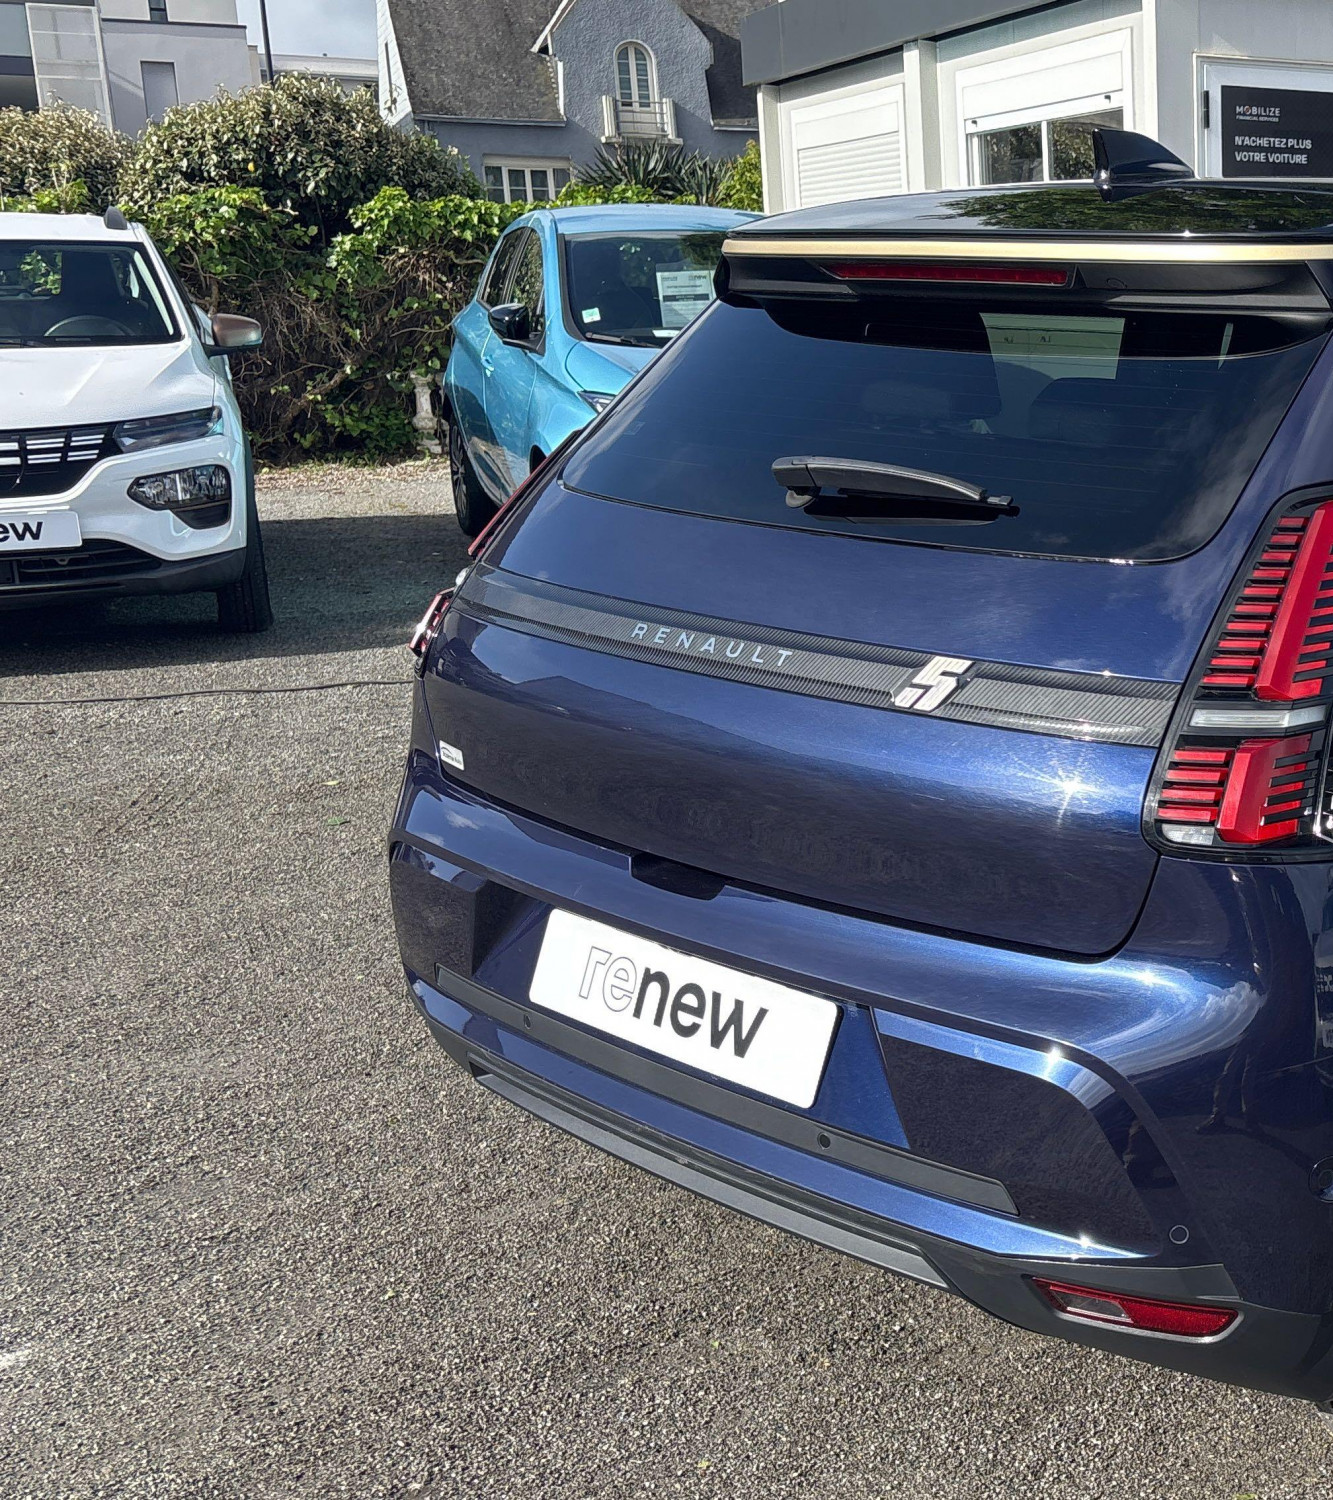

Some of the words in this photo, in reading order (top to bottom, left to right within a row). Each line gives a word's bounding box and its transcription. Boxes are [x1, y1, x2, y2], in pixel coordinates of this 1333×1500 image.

[1236, 105, 1281, 117] MOBILIZE
[1234, 136, 1287, 148] N'ACHETEZ
[1287, 138, 1312, 149] PLUS
[1234, 151, 1267, 162] VOTRE
[1267, 152, 1308, 164] VOITURE
[630, 623, 794, 668] RENAULT
[894, 656, 976, 713] 5
[578, 945, 770, 1059] renew
